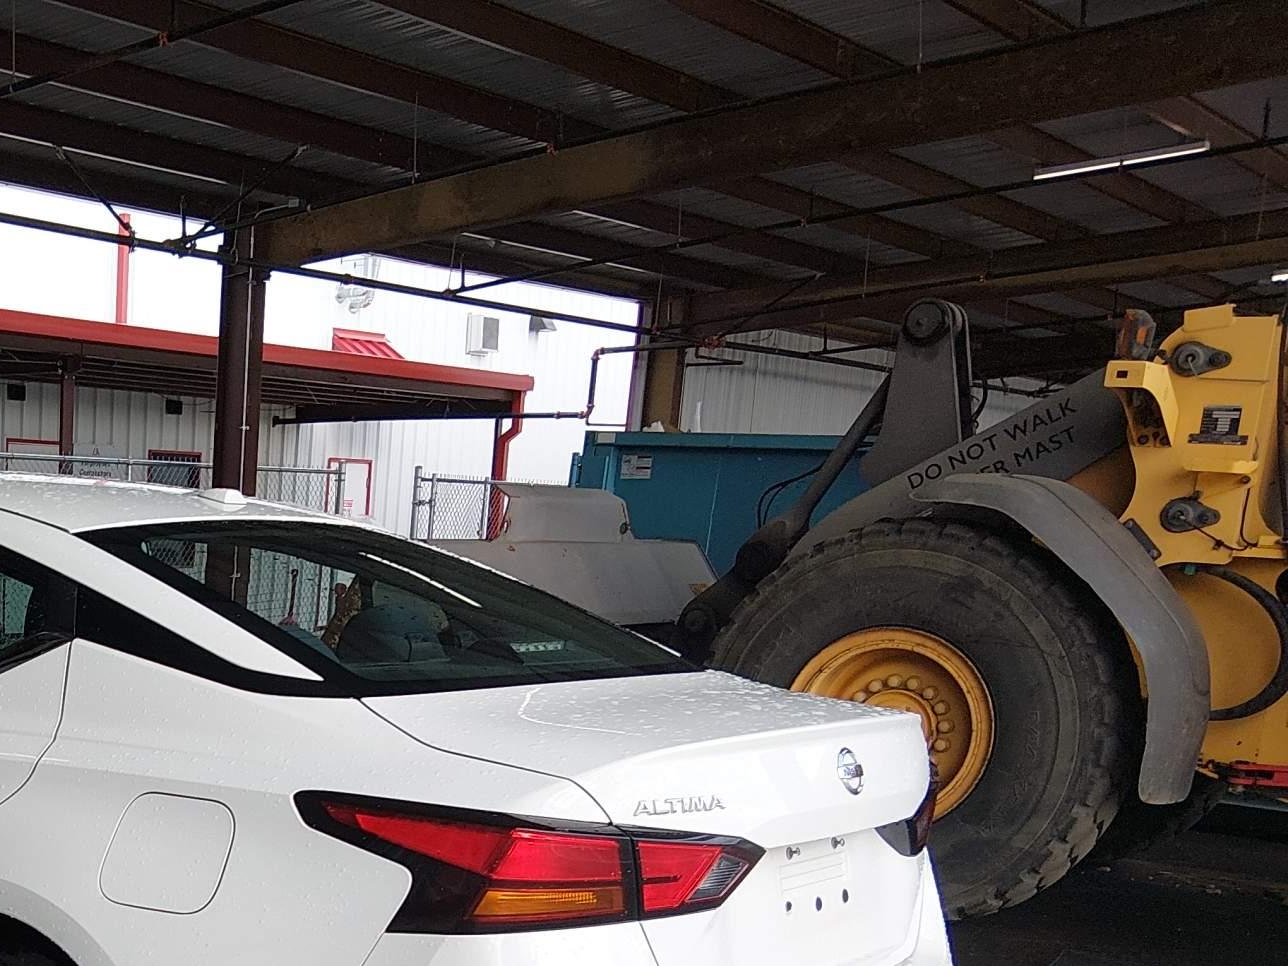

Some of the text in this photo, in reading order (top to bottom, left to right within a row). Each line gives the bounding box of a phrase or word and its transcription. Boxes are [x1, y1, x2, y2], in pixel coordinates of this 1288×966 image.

[907, 398, 1077, 489] DO NOT WALK
[1013, 426, 1075, 467] MAST
[633, 795, 727, 816] ALTIMA
